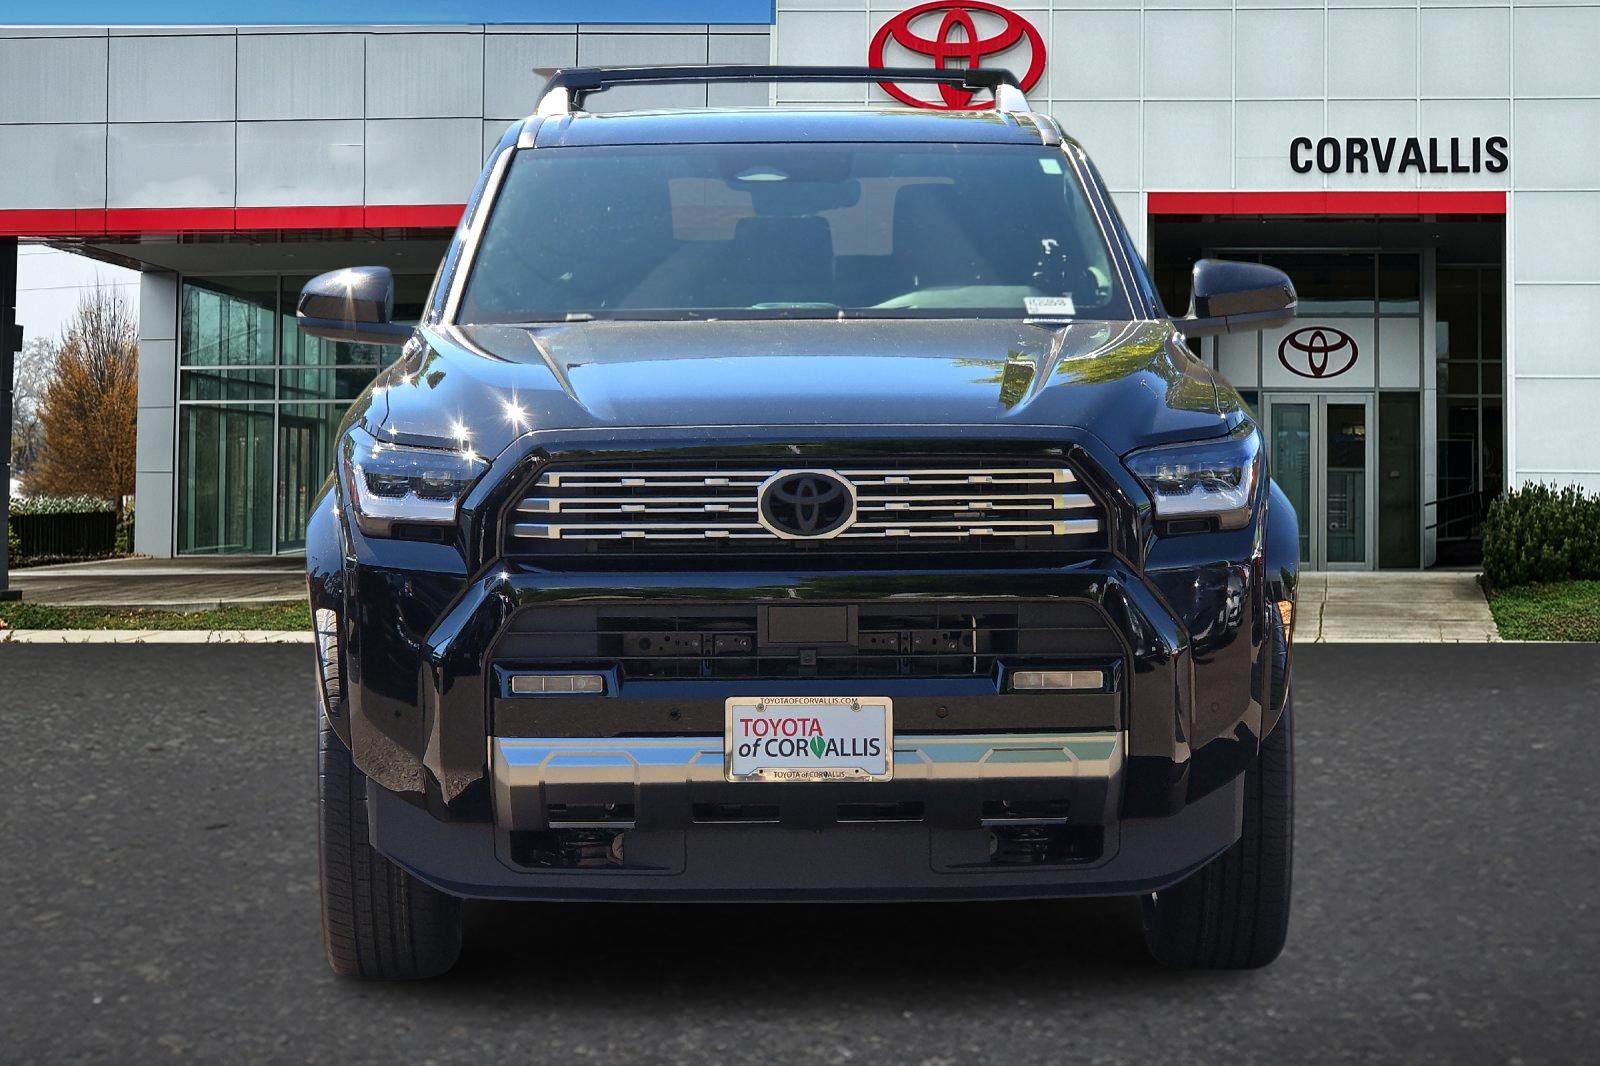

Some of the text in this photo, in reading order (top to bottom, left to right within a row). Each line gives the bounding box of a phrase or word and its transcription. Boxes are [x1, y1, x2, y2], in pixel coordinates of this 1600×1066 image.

[1290, 136, 1509, 174] CORVALLIS
[739, 718, 823, 737] TOYOTA
[738, 738, 762, 758] of
